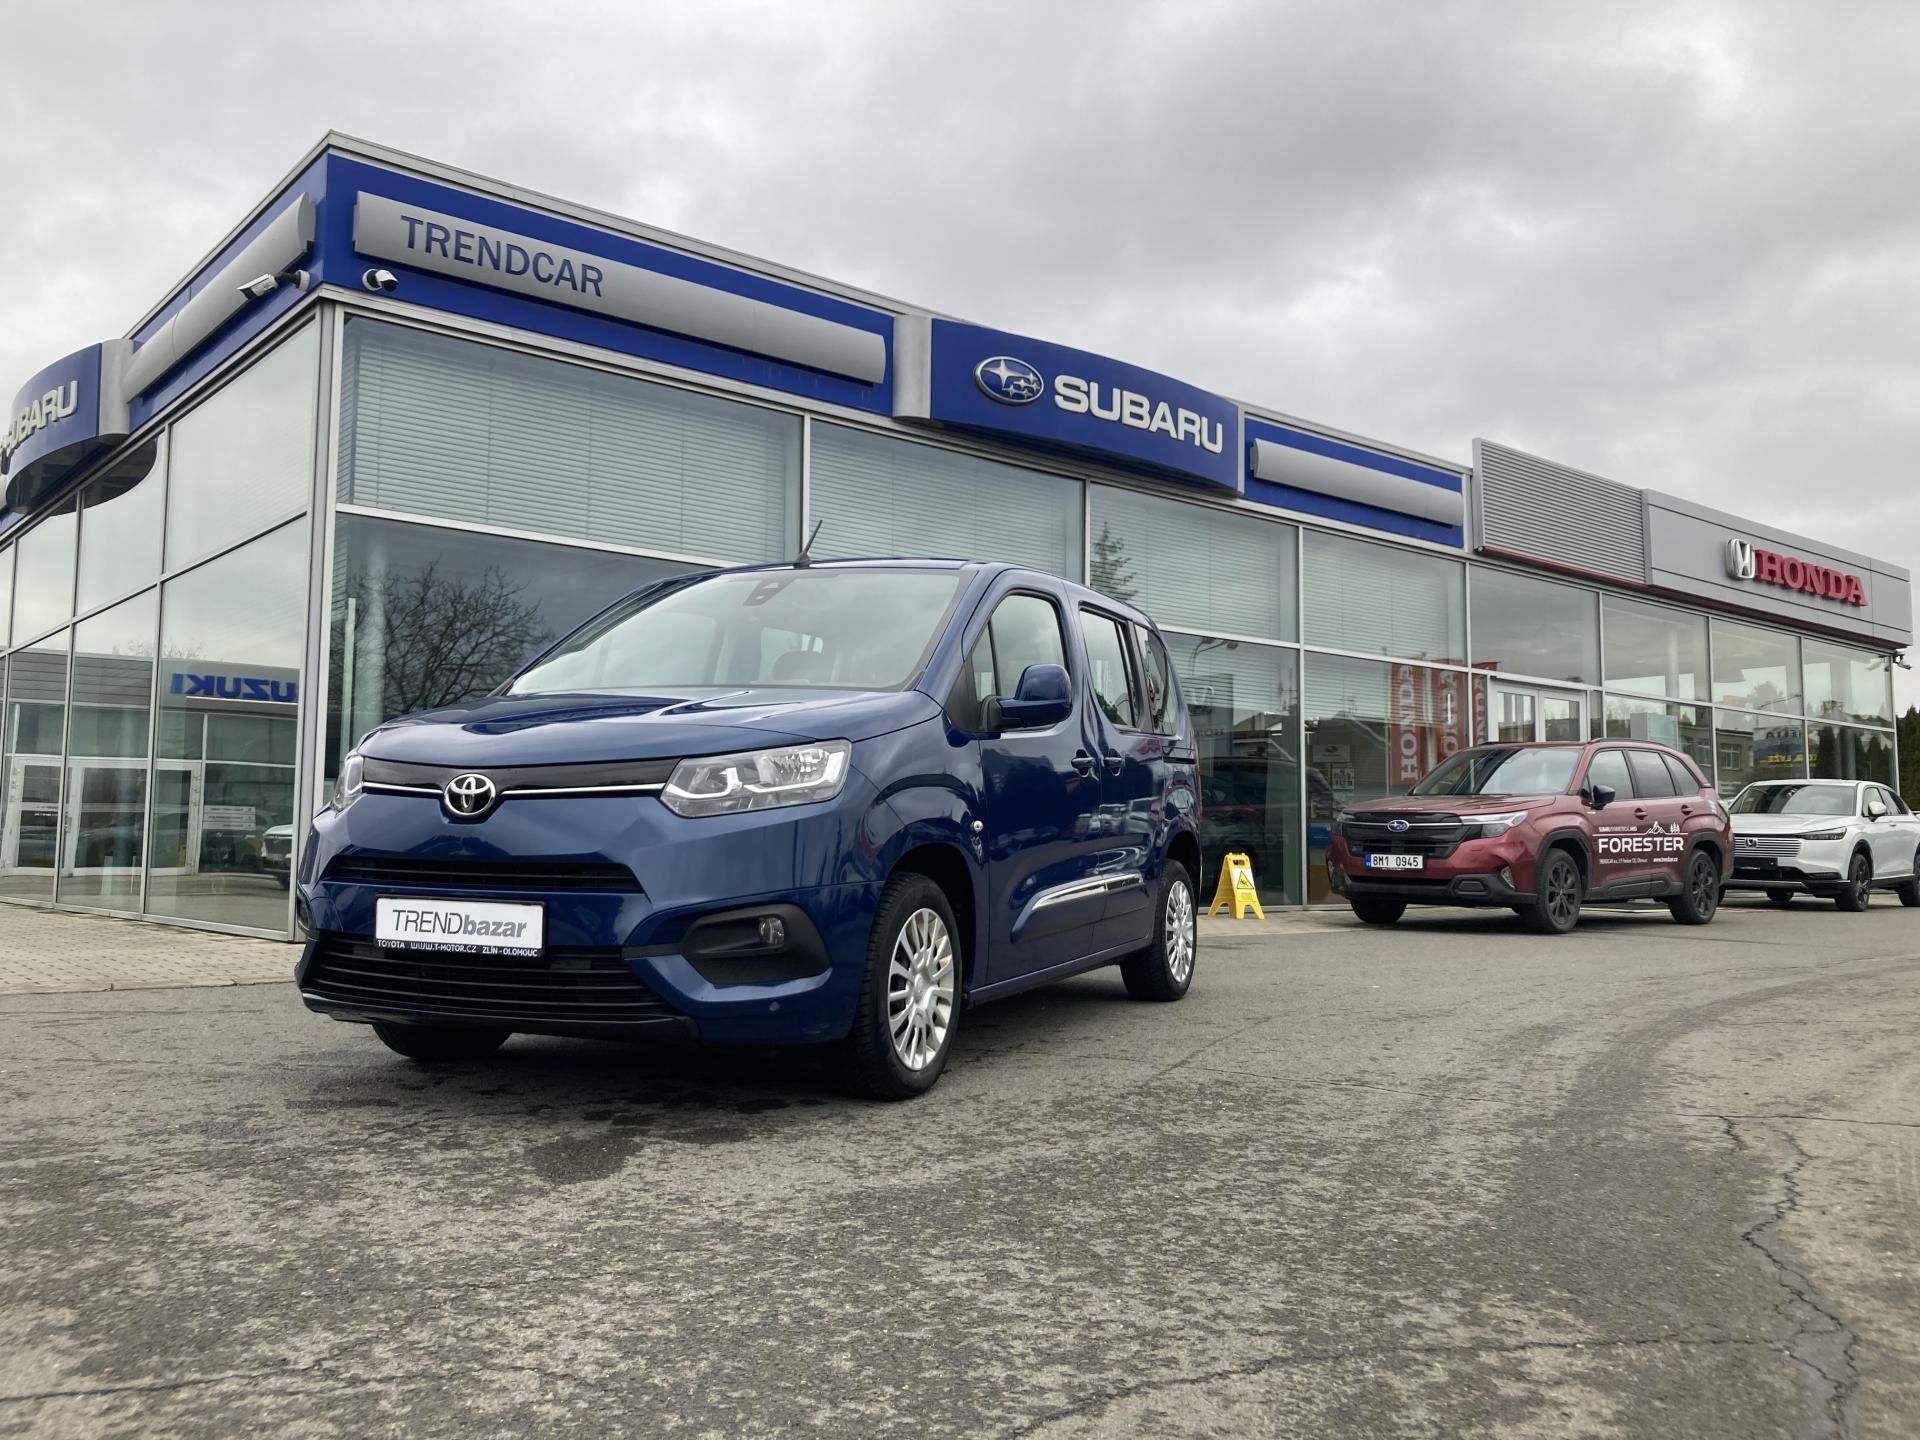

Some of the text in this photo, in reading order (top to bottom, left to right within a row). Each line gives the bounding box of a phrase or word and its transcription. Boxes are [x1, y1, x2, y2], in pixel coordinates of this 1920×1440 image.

[401, 215, 603, 297] TRENDCAR
[1054, 374, 1223, 454] SUBARU
[1753, 549, 1869, 606] HONDA
[1400, 664, 1418, 781] HONDA
[1440, 669, 1459, 760] ONDA
[1373, 855, 1419, 867] 8M1 0945
[1598, 837, 1684, 853] FORESTER
[377, 939, 406, 949] TOYOTA
[503, 947, 538, 957] OLOMOUC
[393, 909, 527, 938] TRENDbazar
